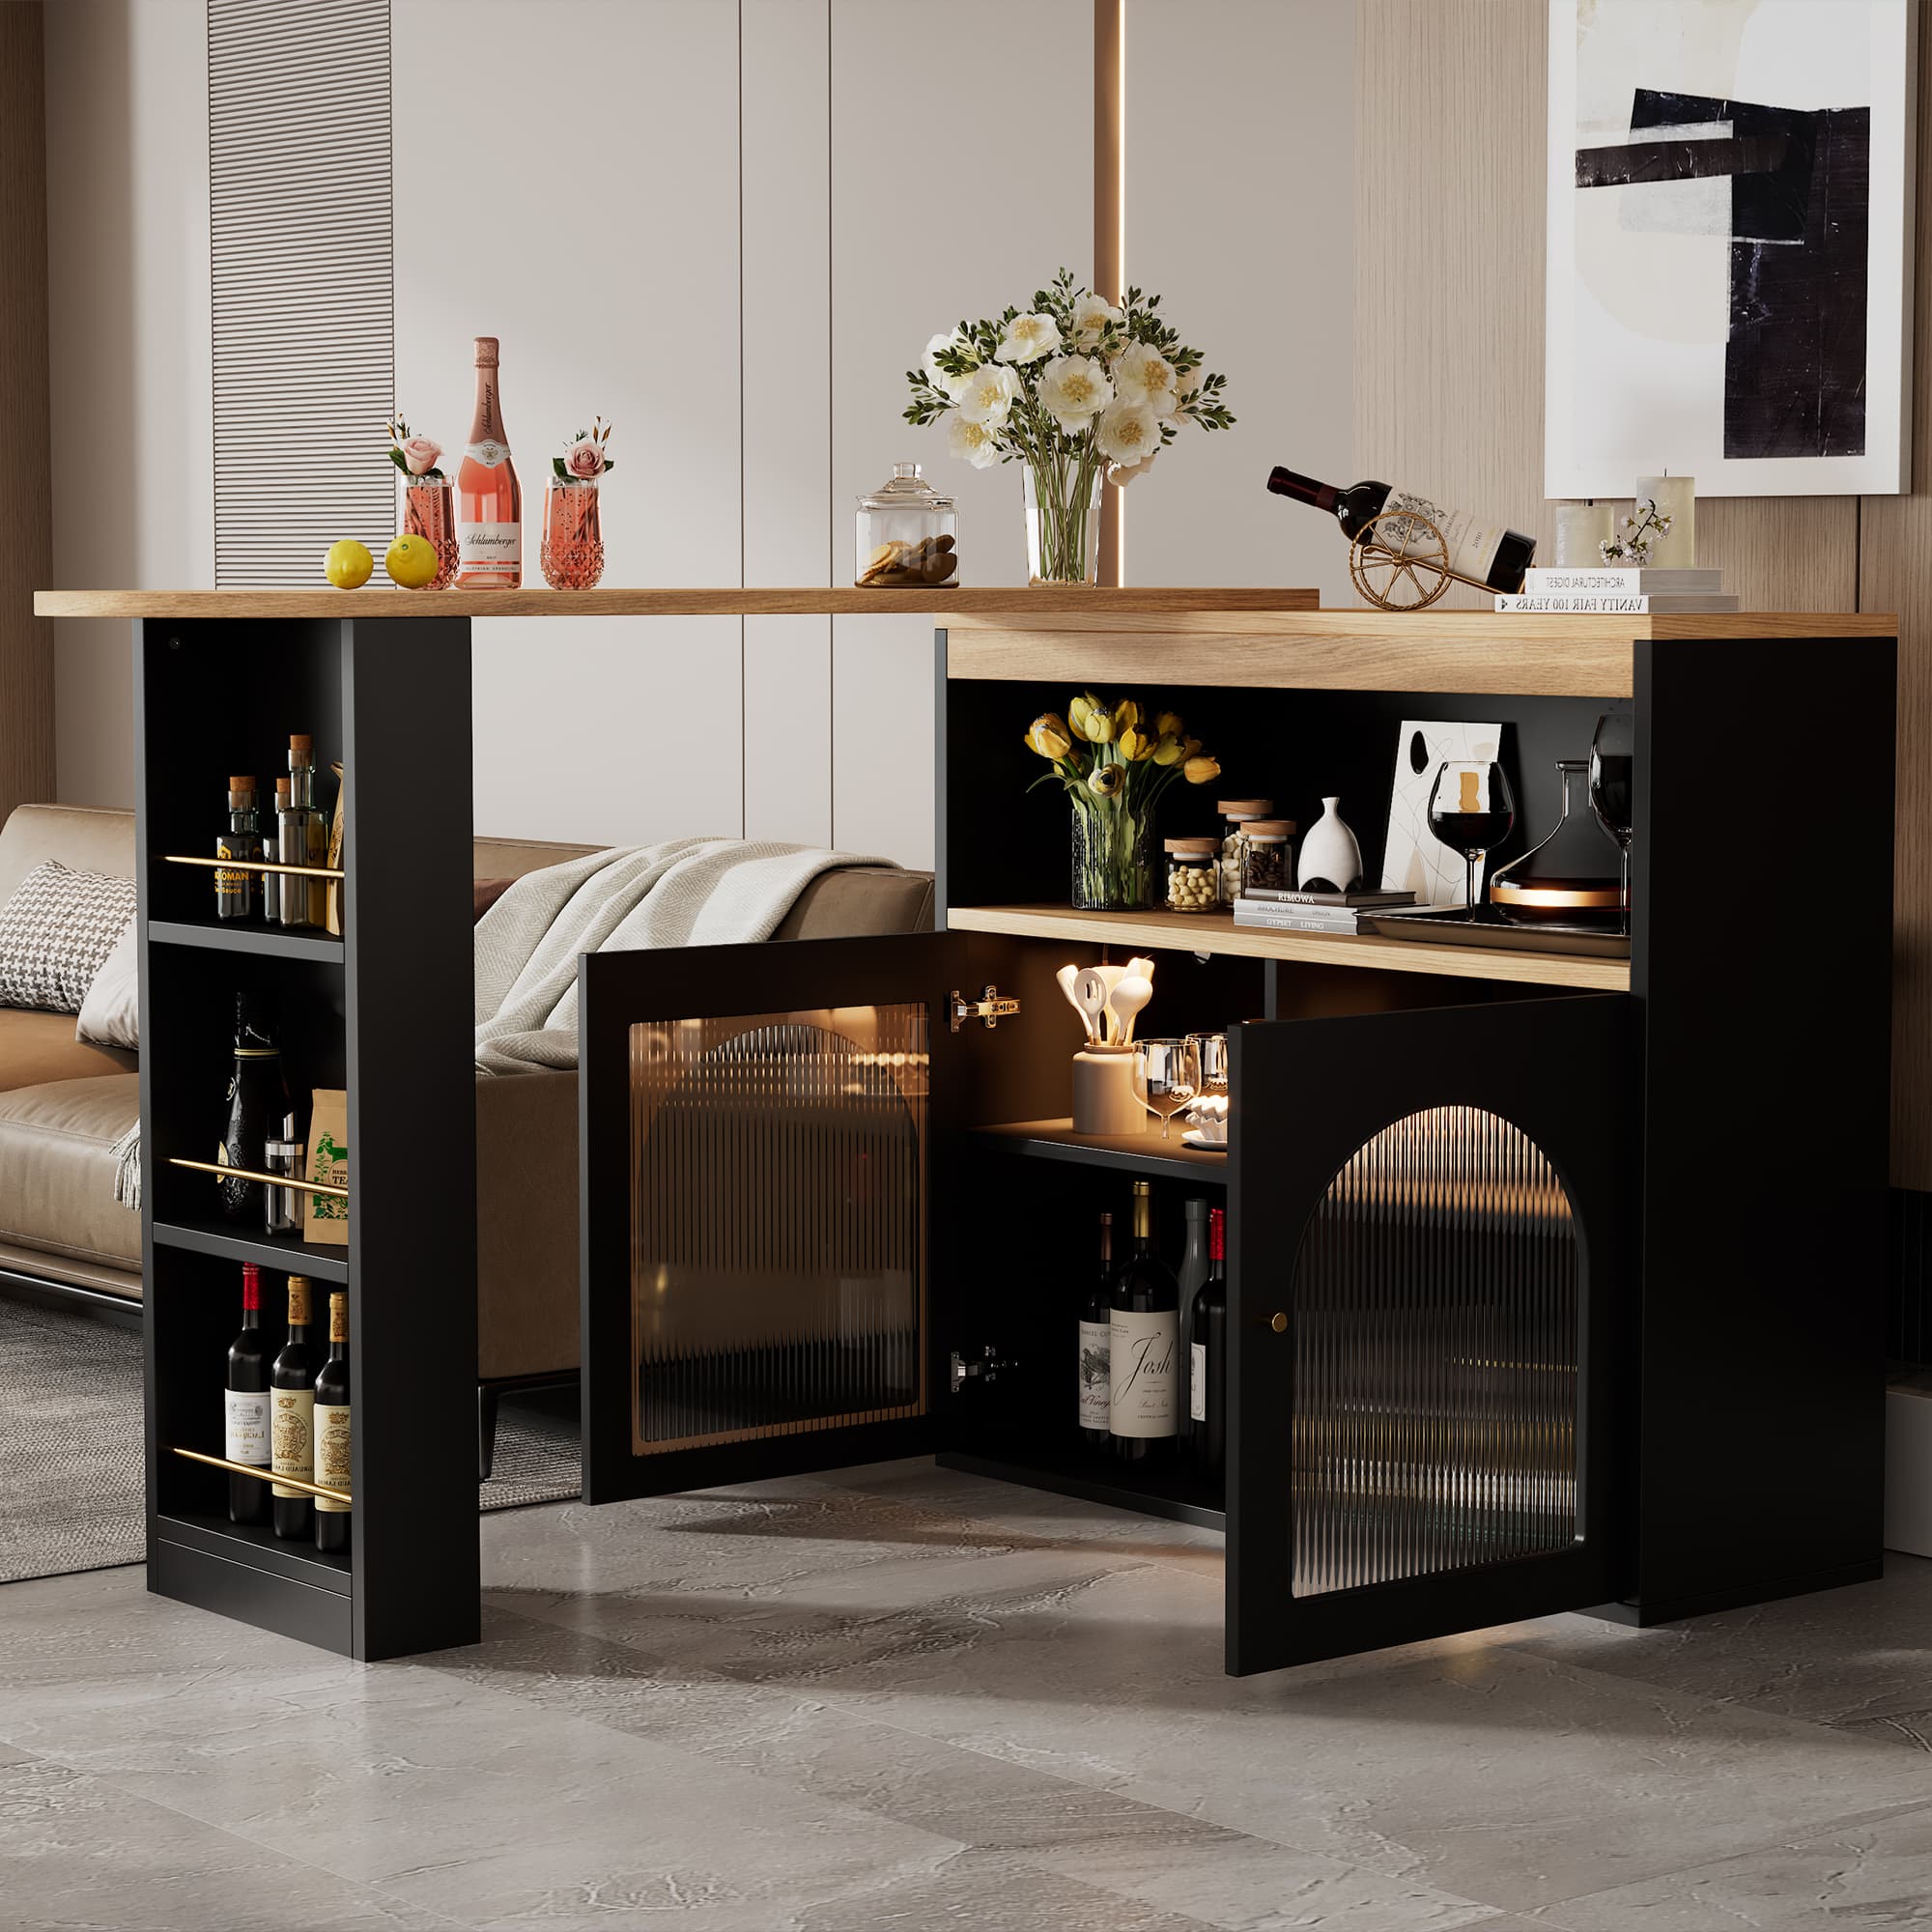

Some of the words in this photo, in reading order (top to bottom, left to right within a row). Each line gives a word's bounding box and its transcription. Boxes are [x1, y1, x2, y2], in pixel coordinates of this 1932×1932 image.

[465, 533, 517, 549] Schlumberger
[1471, 531, 1483, 549] 2010
[1278, 893, 1315, 904] RIMOWA
[1300, 921, 1324, 929] LIVING
[1114, 1331, 1174, 1406] Josh
